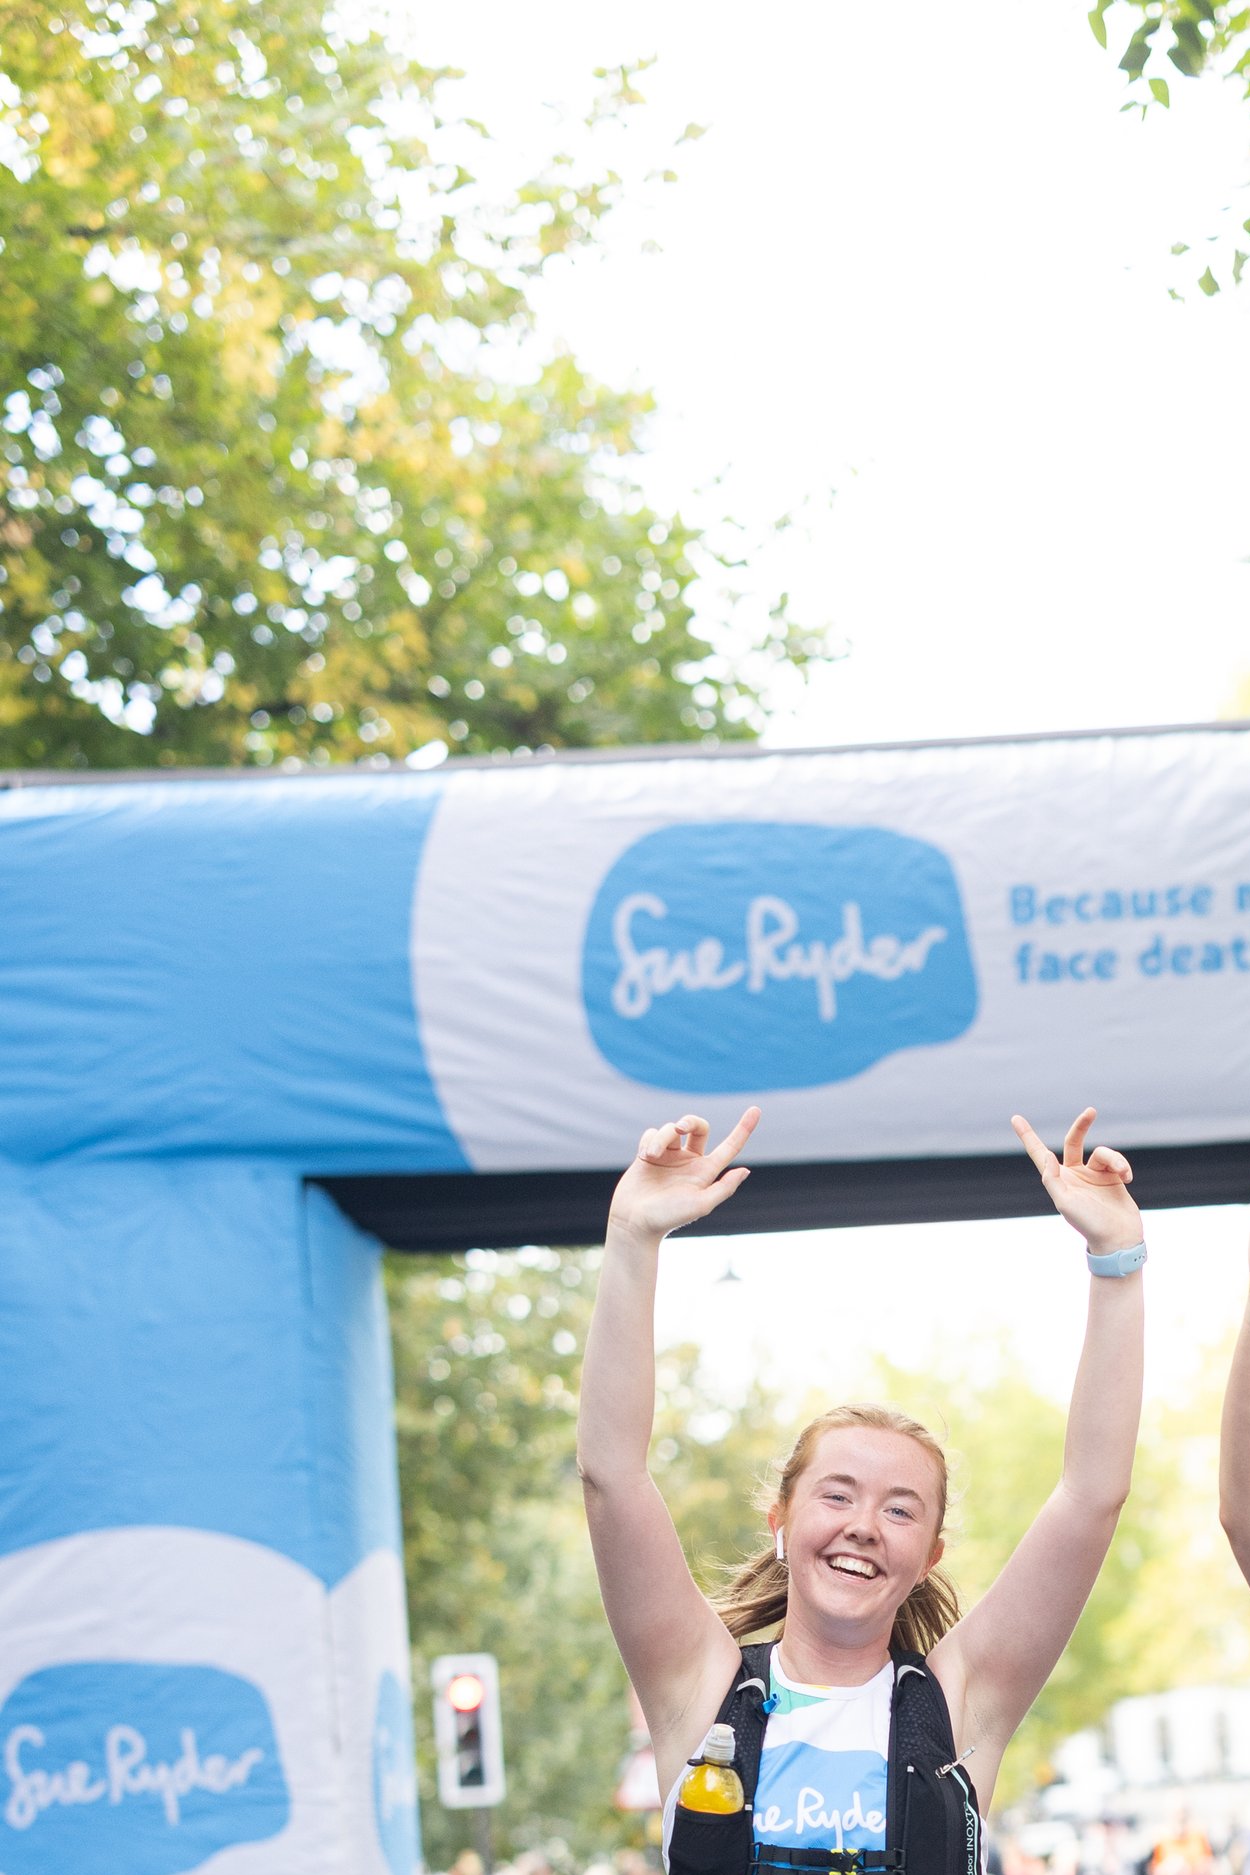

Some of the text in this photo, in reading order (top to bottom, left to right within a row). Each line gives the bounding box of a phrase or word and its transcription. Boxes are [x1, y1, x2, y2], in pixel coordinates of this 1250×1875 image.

[1008, 881, 1214, 927] Because
[610, 893, 947, 1022] Sue Ryder
[1014, 940, 1117, 985] face
[4, 1724, 106, 1830] Sue
[106, 1724, 264, 1827] Ryder
[796, 1787, 887, 1849] Ryde
